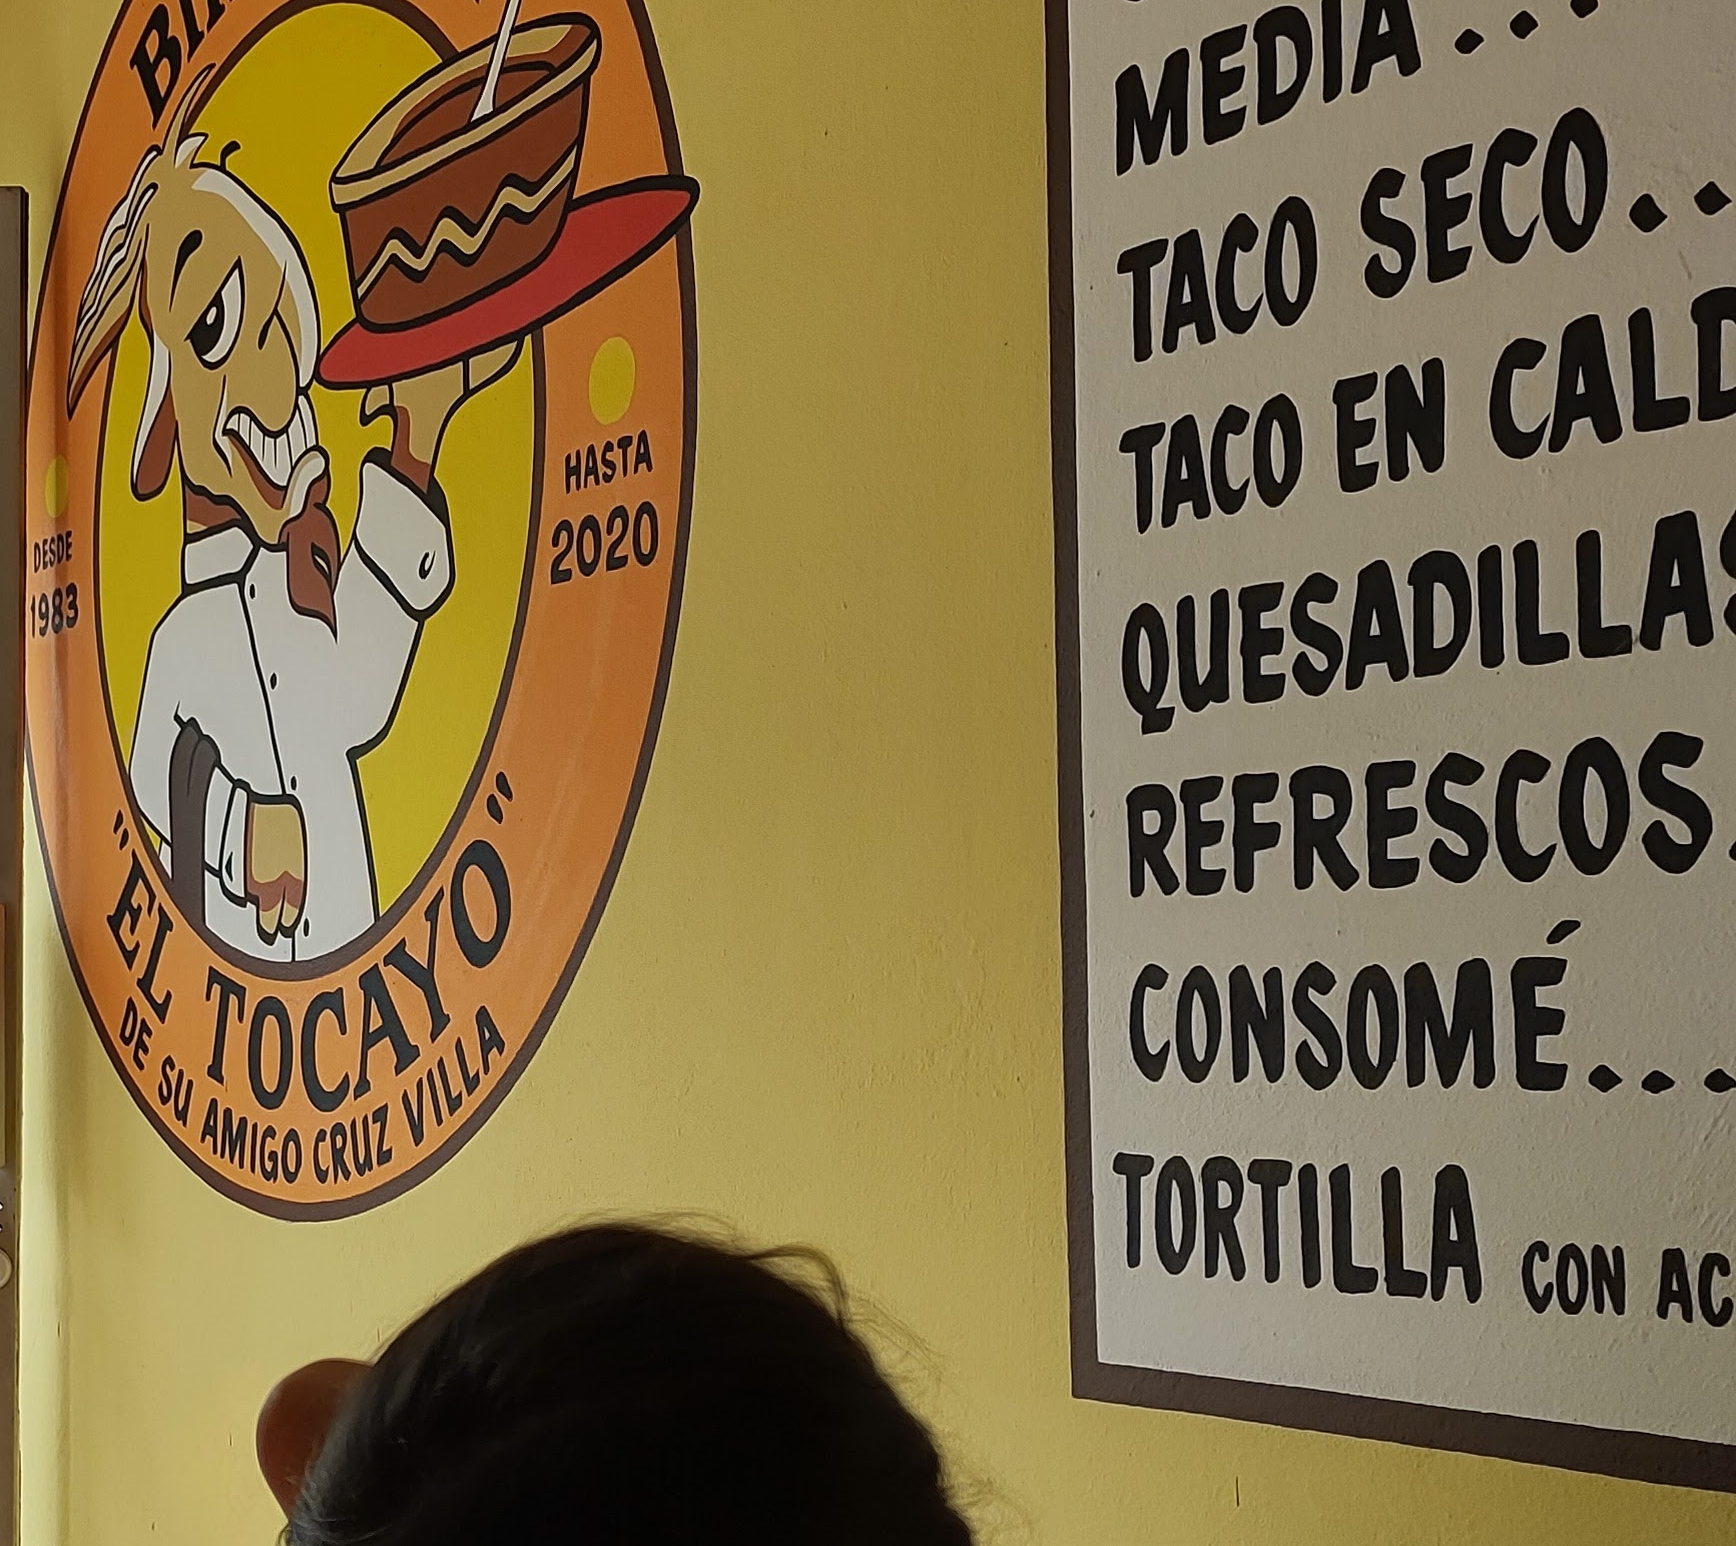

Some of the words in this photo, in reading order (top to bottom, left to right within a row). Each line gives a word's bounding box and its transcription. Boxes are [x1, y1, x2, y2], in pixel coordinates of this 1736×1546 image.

[1116, 196, 1318, 363] TACO
[564, 429, 654, 495] HASTA
[1118, 393, 1303, 535] TACO
[1332, 357, 1446, 493] EN
[1489, 286, 1736, 460] CALD
[30, 581, 79, 639] 1983
[33, 530, 74, 574] DESDE
[550, 500, 659, 585] 2020
[1125, 731, 1713, 898] REFRESCOS
[119, 995, 154, 1072] DE
[156, 1054, 194, 1128] SU
[201, 1097, 303, 1185] AMIGO
[311, 1109, 394, 1185] CRUZ
[402, 1006, 506, 1148] VILLA
[1112, 1152, 1482, 1304] TORTILLA
[1521, 1240, 1626, 1316] CON
[1656, 1247, 1734, 1328] AC
